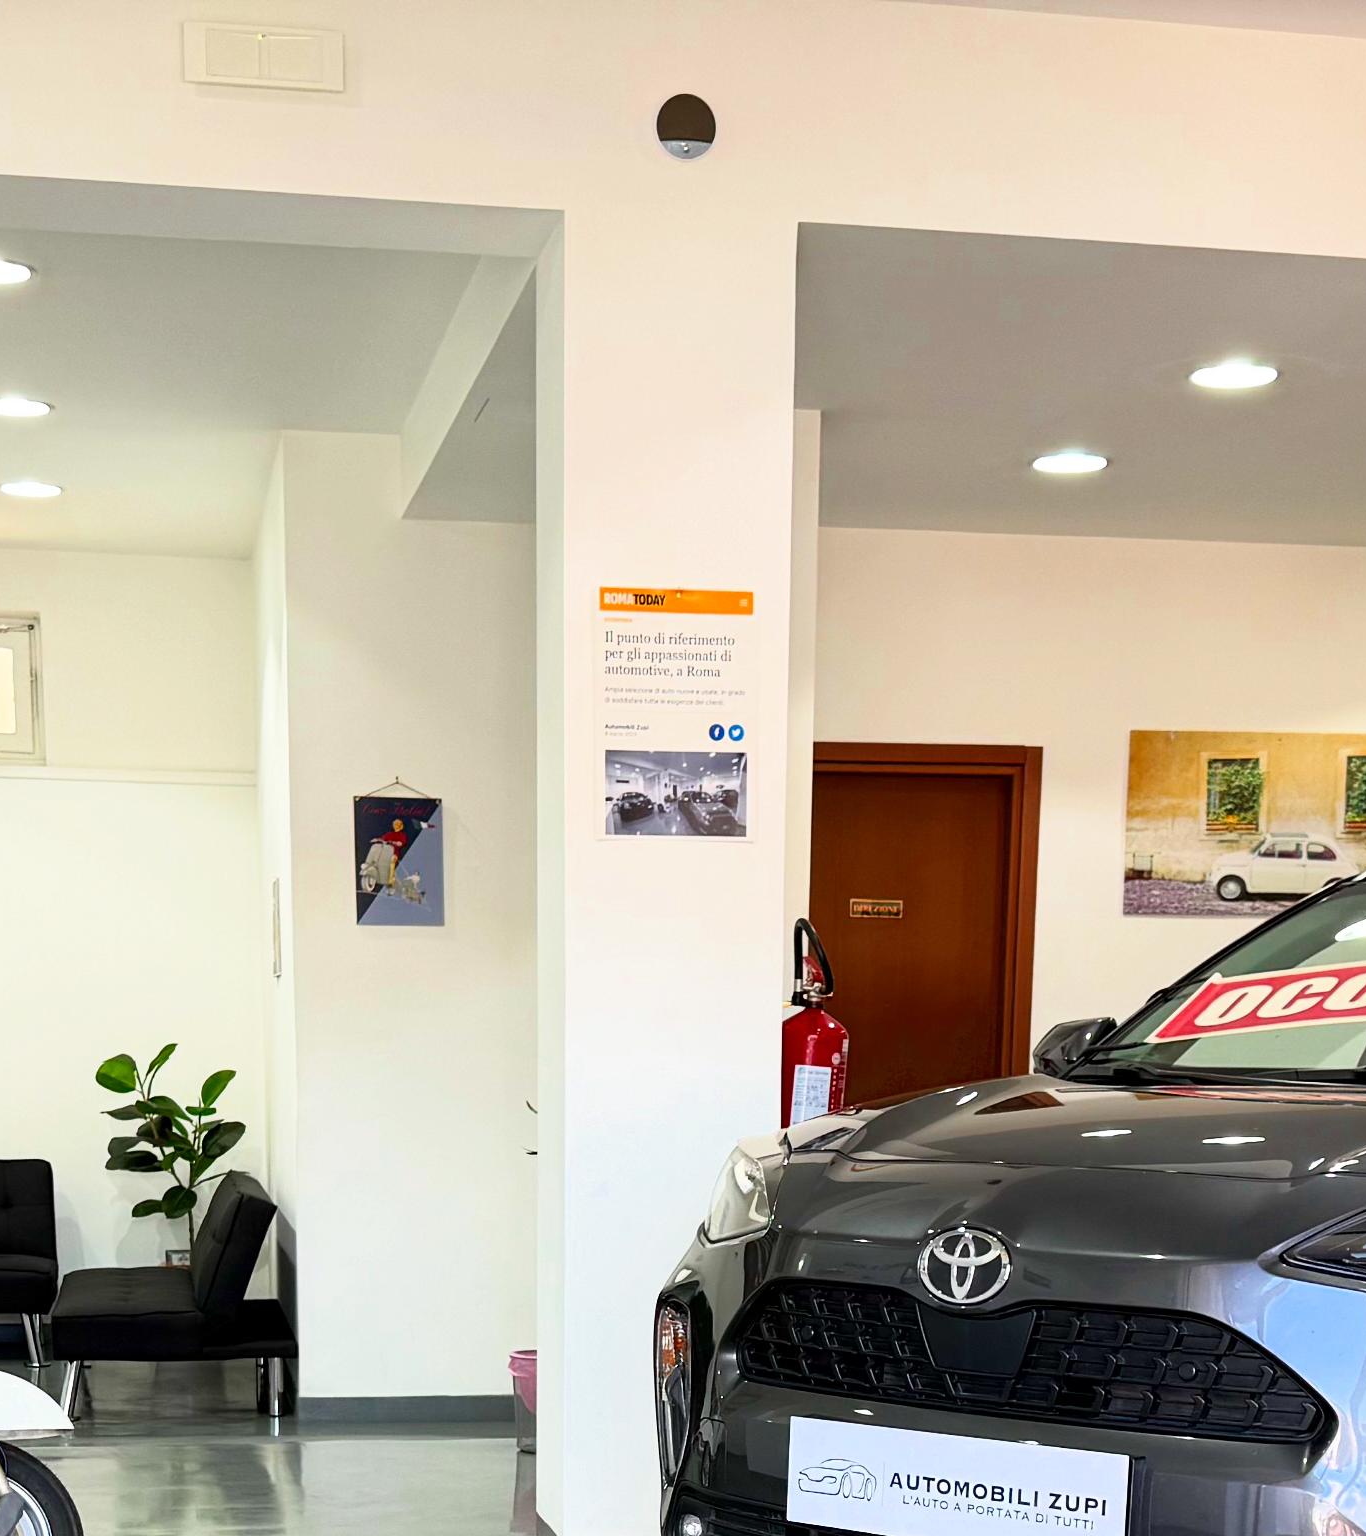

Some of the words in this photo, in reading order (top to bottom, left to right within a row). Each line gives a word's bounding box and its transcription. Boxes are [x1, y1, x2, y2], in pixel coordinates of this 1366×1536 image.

[605, 631, 614, 643] Il
[617, 633, 651, 646] punto
[654, 632, 665, 644] di
[669, 633, 735, 647] riferimento
[604, 650, 624, 661] per
[627, 648, 642, 661] gli
[644, 649, 717, 663] appassionati
[720, 650, 732, 662] di
[604, 664, 673, 677] automotive,
[676, 667, 683, 677] a
[686, 665, 721, 678] Roma
[890, 1472, 1038, 1507] AUTOMOBILI
[1048, 1493, 1106, 1516] ZUPI
[902, 1495, 949, 1510] L'AUTO
[953, 1503, 962, 1512] A
[967, 1504, 1030, 1521] PORTATA
[1035, 1513, 1048, 1523] DI
[1054, 1515, 1094, 1530] TUTTI
